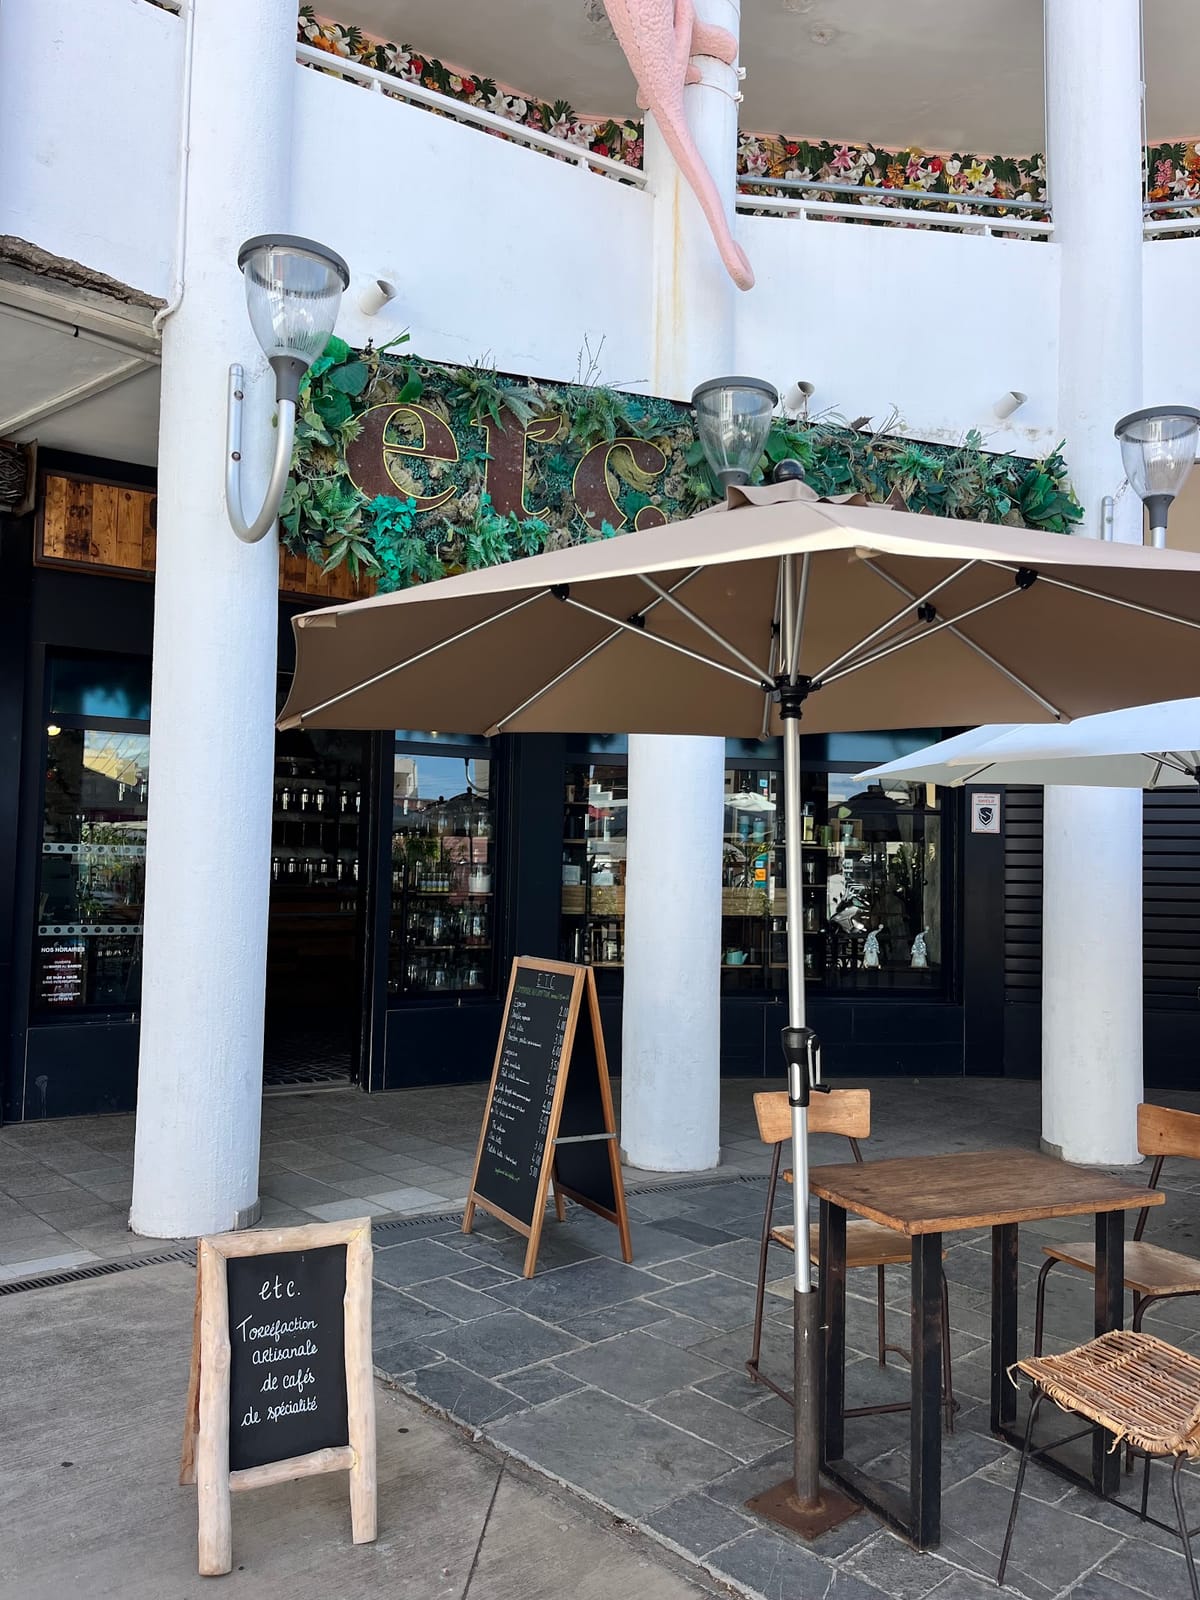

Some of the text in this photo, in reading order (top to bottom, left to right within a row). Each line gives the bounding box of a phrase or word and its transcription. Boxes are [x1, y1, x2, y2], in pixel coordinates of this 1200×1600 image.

[536, 973, 556, 989] ETC
[259, 1275, 301, 1300] etc.
[236, 1315, 318, 1343] Torréfaction
[260, 1367, 316, 1392] de cafés
[240, 1396, 318, 1427] de spécialité
